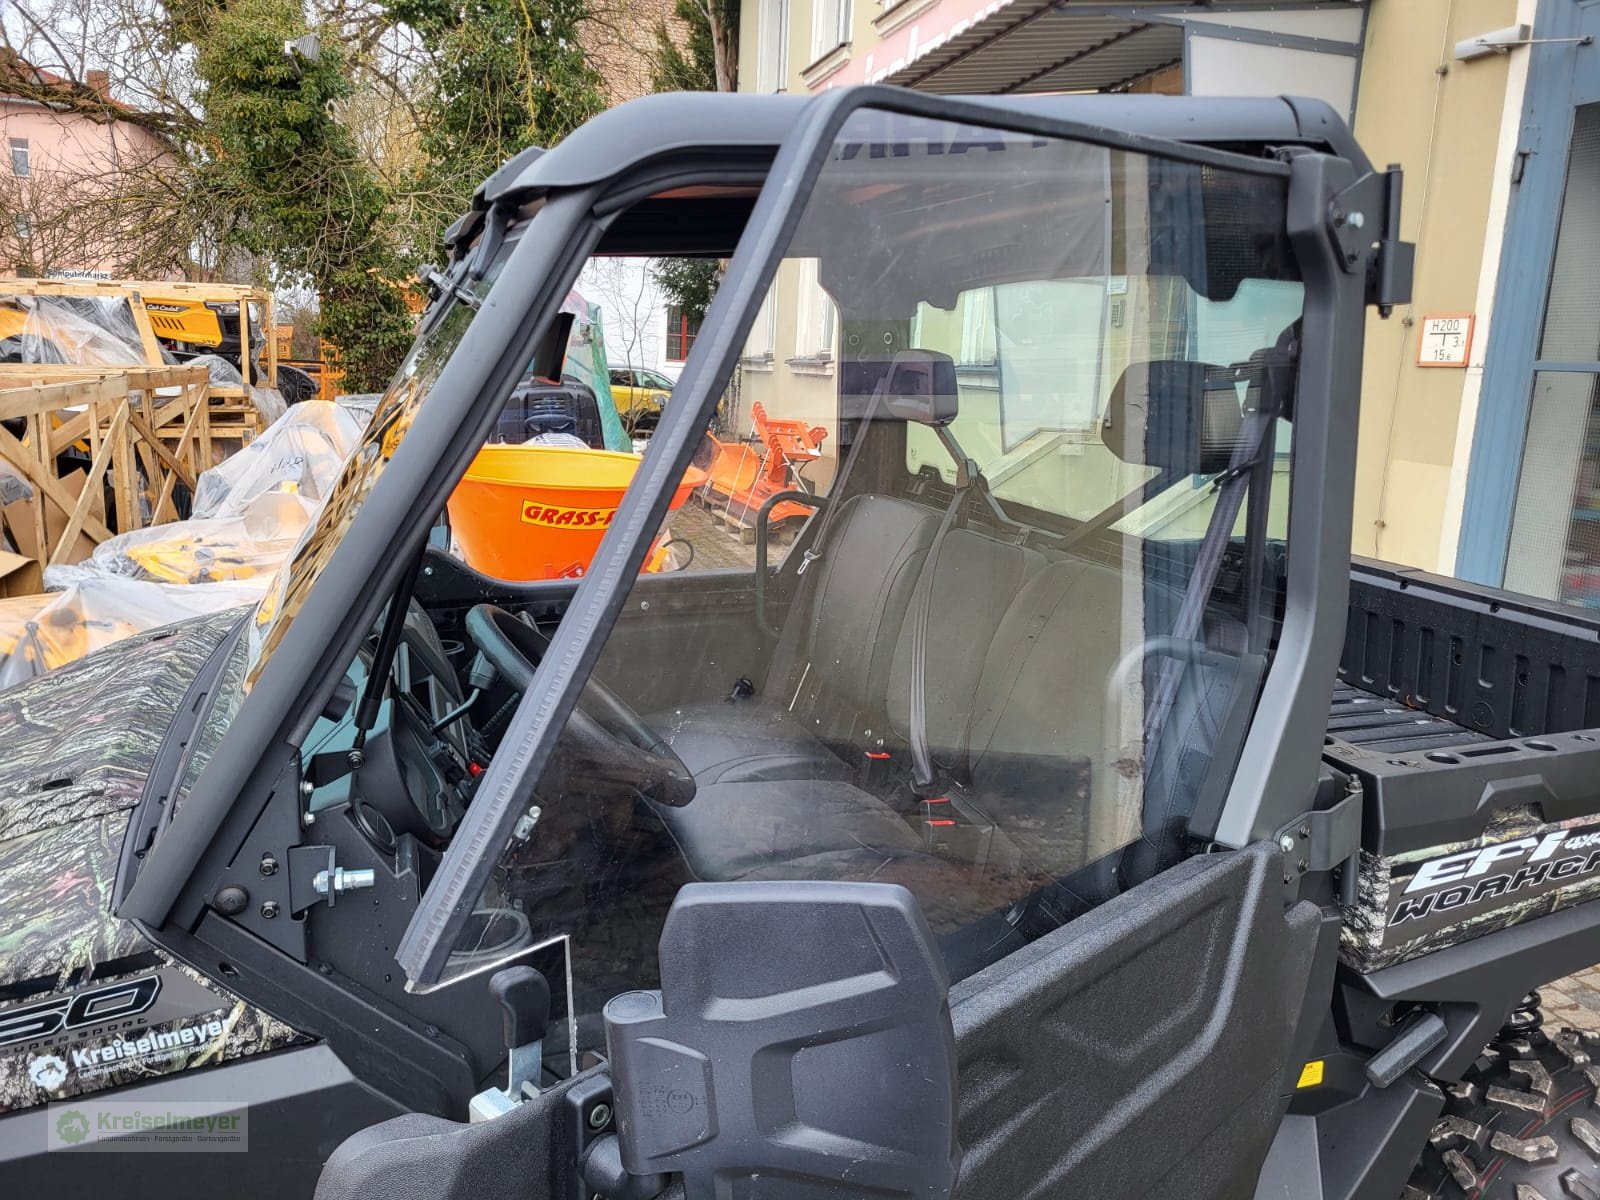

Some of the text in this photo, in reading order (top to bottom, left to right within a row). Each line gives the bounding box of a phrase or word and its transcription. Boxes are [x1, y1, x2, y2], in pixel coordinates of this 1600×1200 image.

[1432, 319, 1460, 331] H200
[1433, 349, 1452, 361] 15.6
[1403, 830, 1570, 894] EFI
[78, 1017, 148, 1037] SPORT
[72, 1017, 231, 1068] Kreiselmeyer
